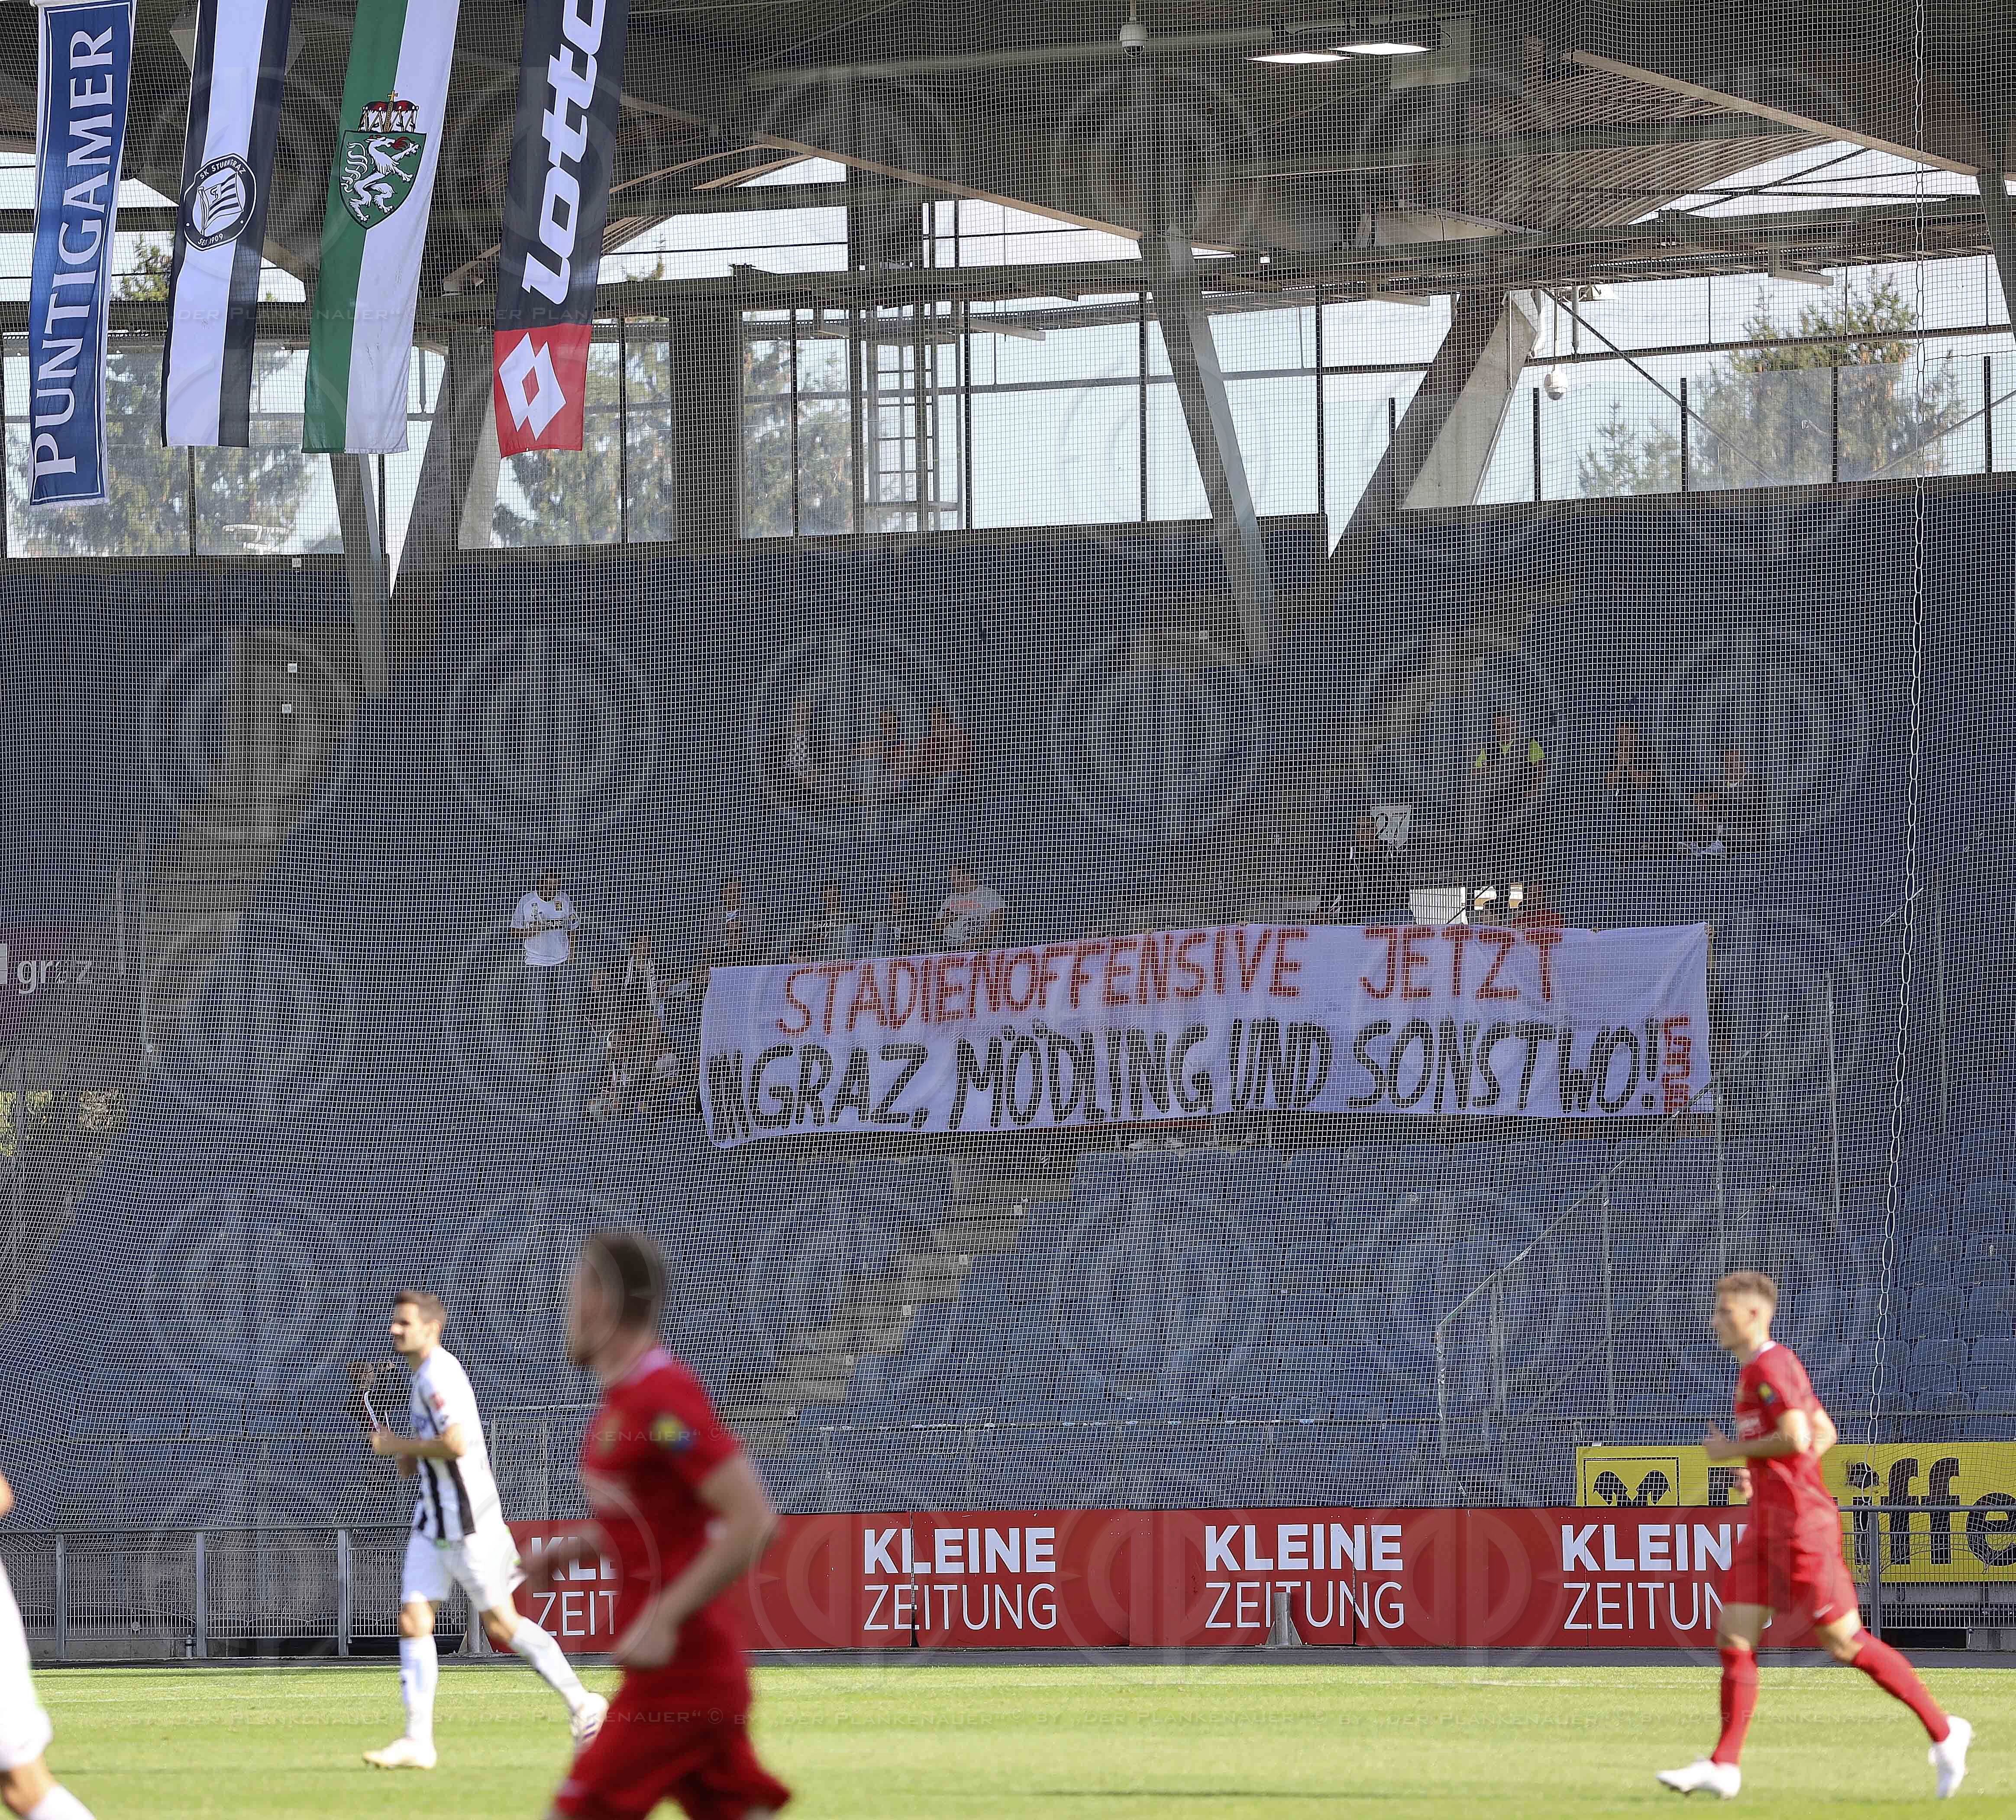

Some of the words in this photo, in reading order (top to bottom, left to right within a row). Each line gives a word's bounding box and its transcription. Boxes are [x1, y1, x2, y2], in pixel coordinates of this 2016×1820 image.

[200, 170, 210, 180] SK
[229, 159, 247, 175] GRAZ
[34, 26, 113, 480] PUNTIGAMER
[209, 233, 224, 245] 1909
[775, 927, 1308, 1039] STADIENOFFENSIVE
[1360, 923, 1562, 1003] JETZT
[748, 1042, 929, 1131] GRAZ,
[948, 1018, 1215, 1131] MÖDLING
[1228, 1016, 1333, 1112] UND
[1708, 1457, 2016, 1567] iffe
[864, 1527, 1056, 1574] KLEINE
[1205, 1523, 1403, 1571] KLEINE
[1561, 1523, 1749, 1572] KLEIN
[532, 1590, 620, 1636] ZEIT
[864, 1583, 1057, 1630] ZEITUNG
[1564, 1582, 1772, 1630] ZEITUN
